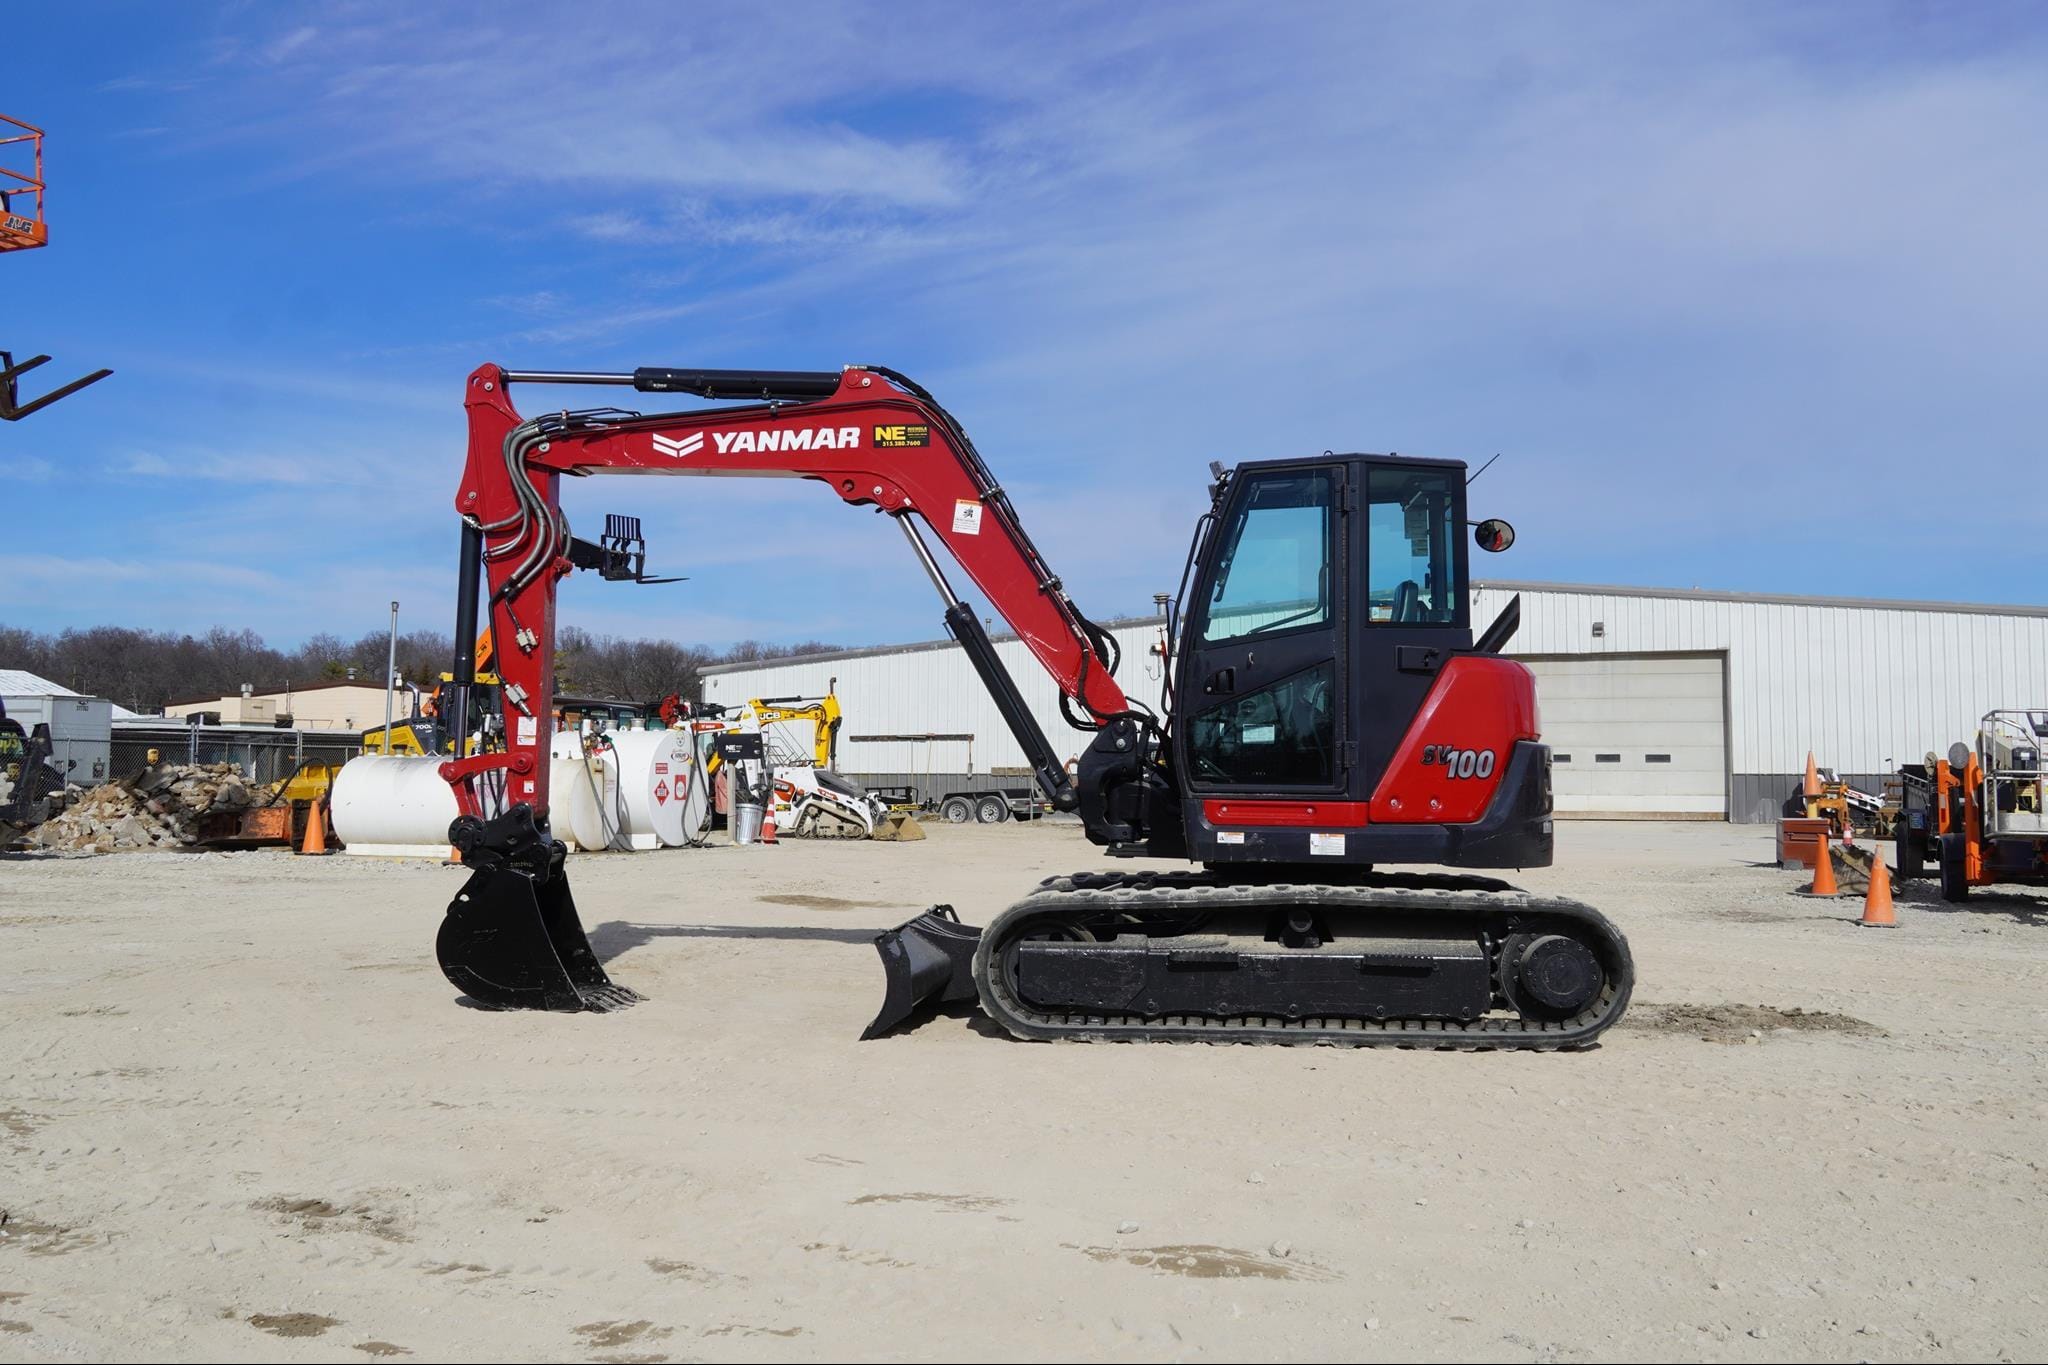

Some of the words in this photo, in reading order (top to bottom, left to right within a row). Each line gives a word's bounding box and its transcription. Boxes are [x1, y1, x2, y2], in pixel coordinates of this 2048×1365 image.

[3, 216, 33, 234] JLG
[711, 427, 861, 454] YANMAR
[875, 426, 906, 440] NE
[760, 711, 781, 720] JCB
